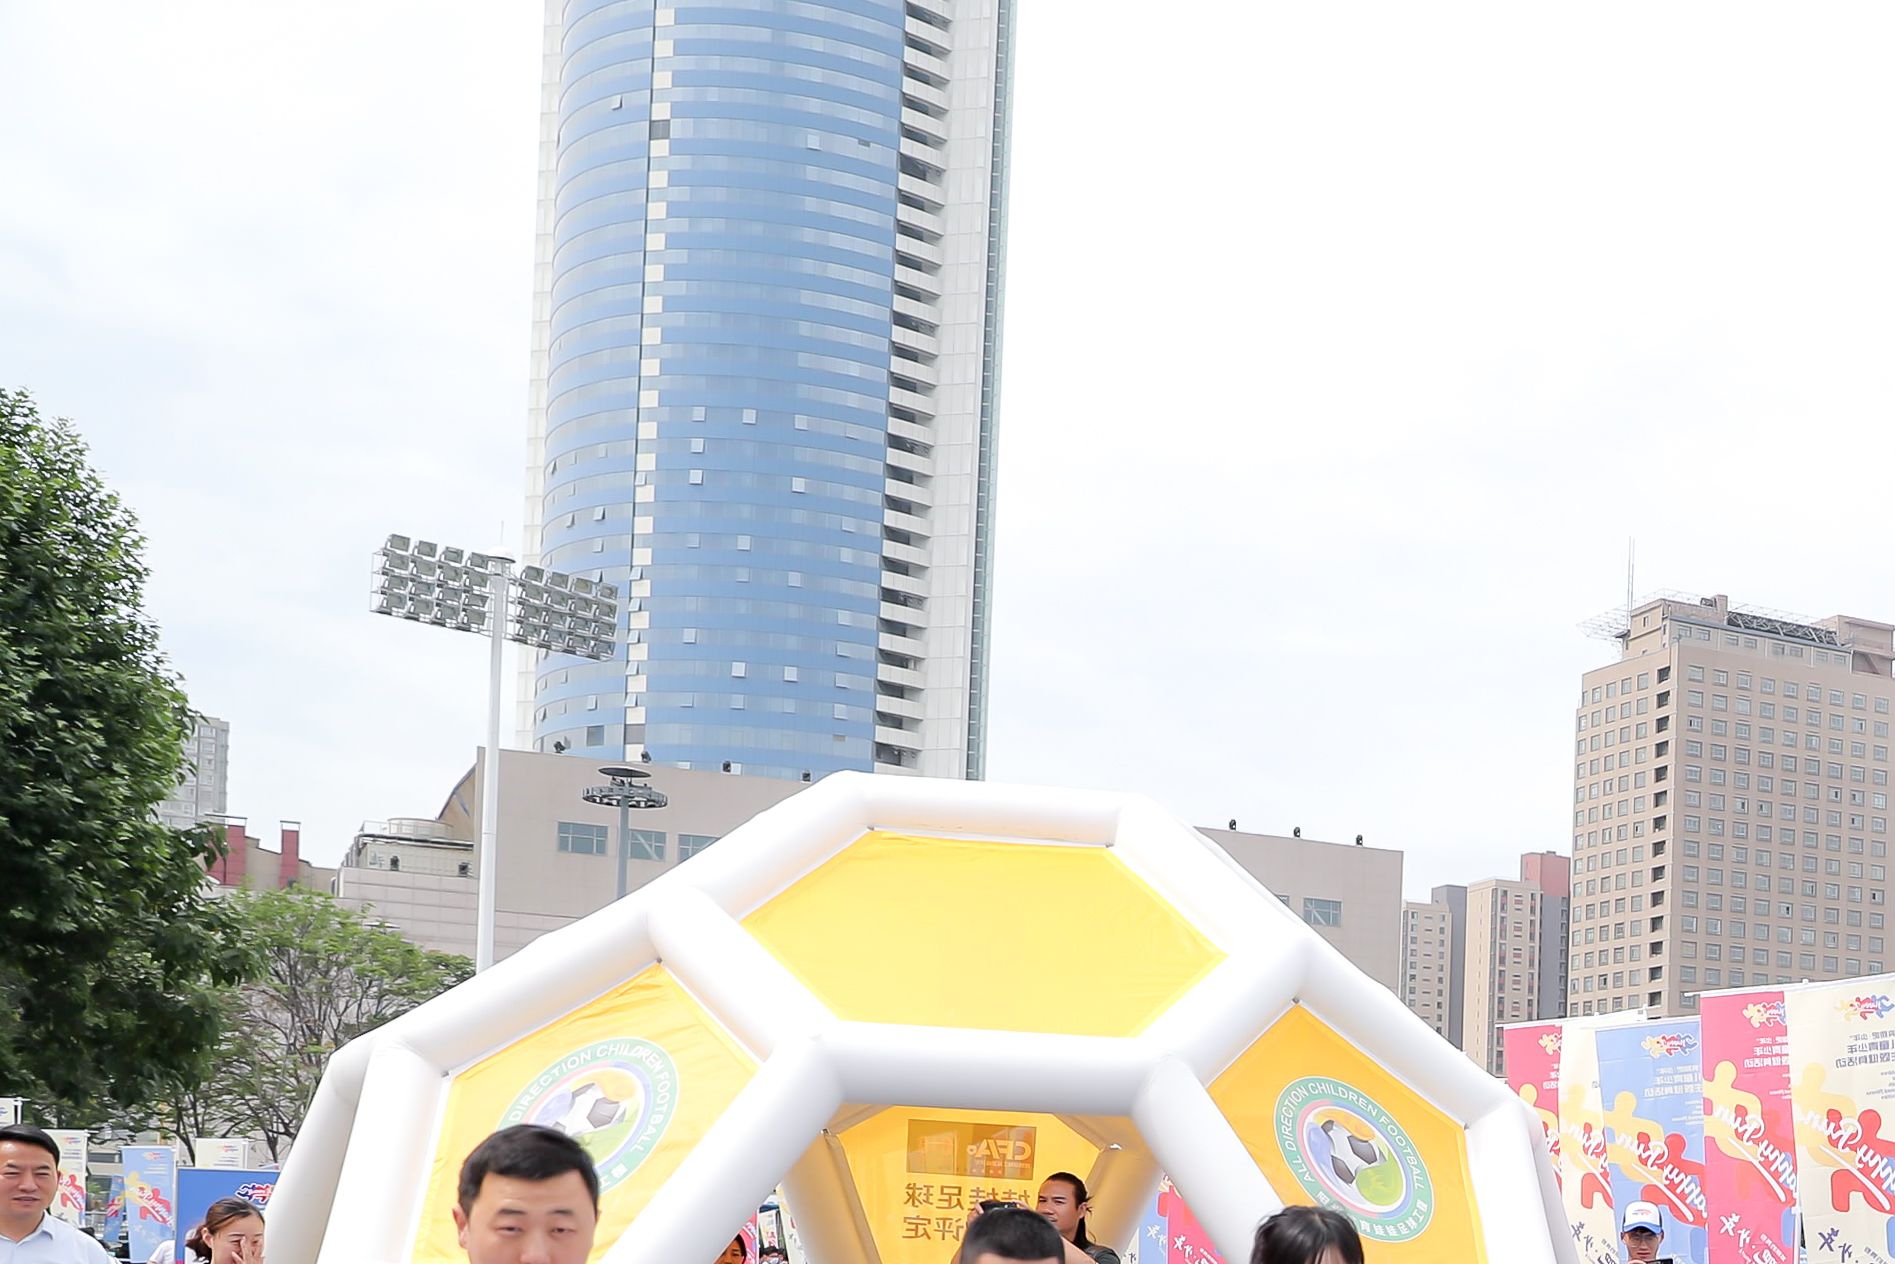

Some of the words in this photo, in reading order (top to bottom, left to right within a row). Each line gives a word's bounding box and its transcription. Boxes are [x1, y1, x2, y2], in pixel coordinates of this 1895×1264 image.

[509, 1051, 594, 1120] DIRECTION
[595, 1041, 661, 1074] CHILDREN
[1307, 1081, 1379, 1117] CHILDREN
[1281, 1083, 1309, 1152] DIRECTION
[1379, 1114, 1426, 1190] FOOTBALL
[1291, 1155, 1317, 1183] ALL
